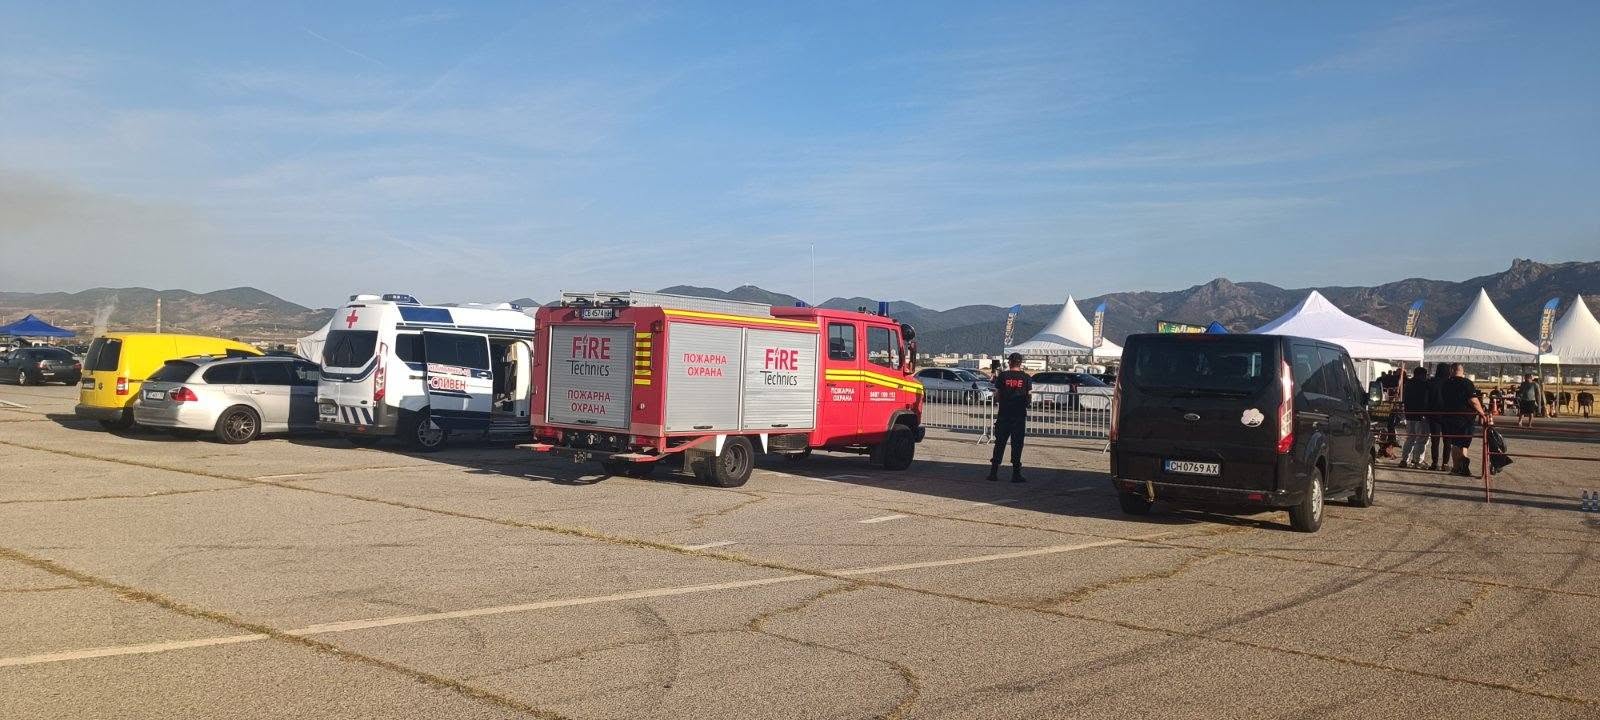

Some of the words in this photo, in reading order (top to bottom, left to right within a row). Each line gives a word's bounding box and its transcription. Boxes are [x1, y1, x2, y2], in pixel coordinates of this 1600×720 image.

[1541, 309, 1551, 339] CIRCLE
[683, 353, 727, 365] ПОЖАРНА
[566, 360, 610, 377] Technics
[687, 366, 722, 377] ОХРАНА
[760, 371, 798, 386] Technics
[567, 389, 611, 402] ПОЖАРНА
[571, 402, 606, 414] ОХРАНА
[1170, 461, 1182, 471] CH
[1183, 462, 1205, 472] 0769
[1206, 464, 1218, 474] AX
